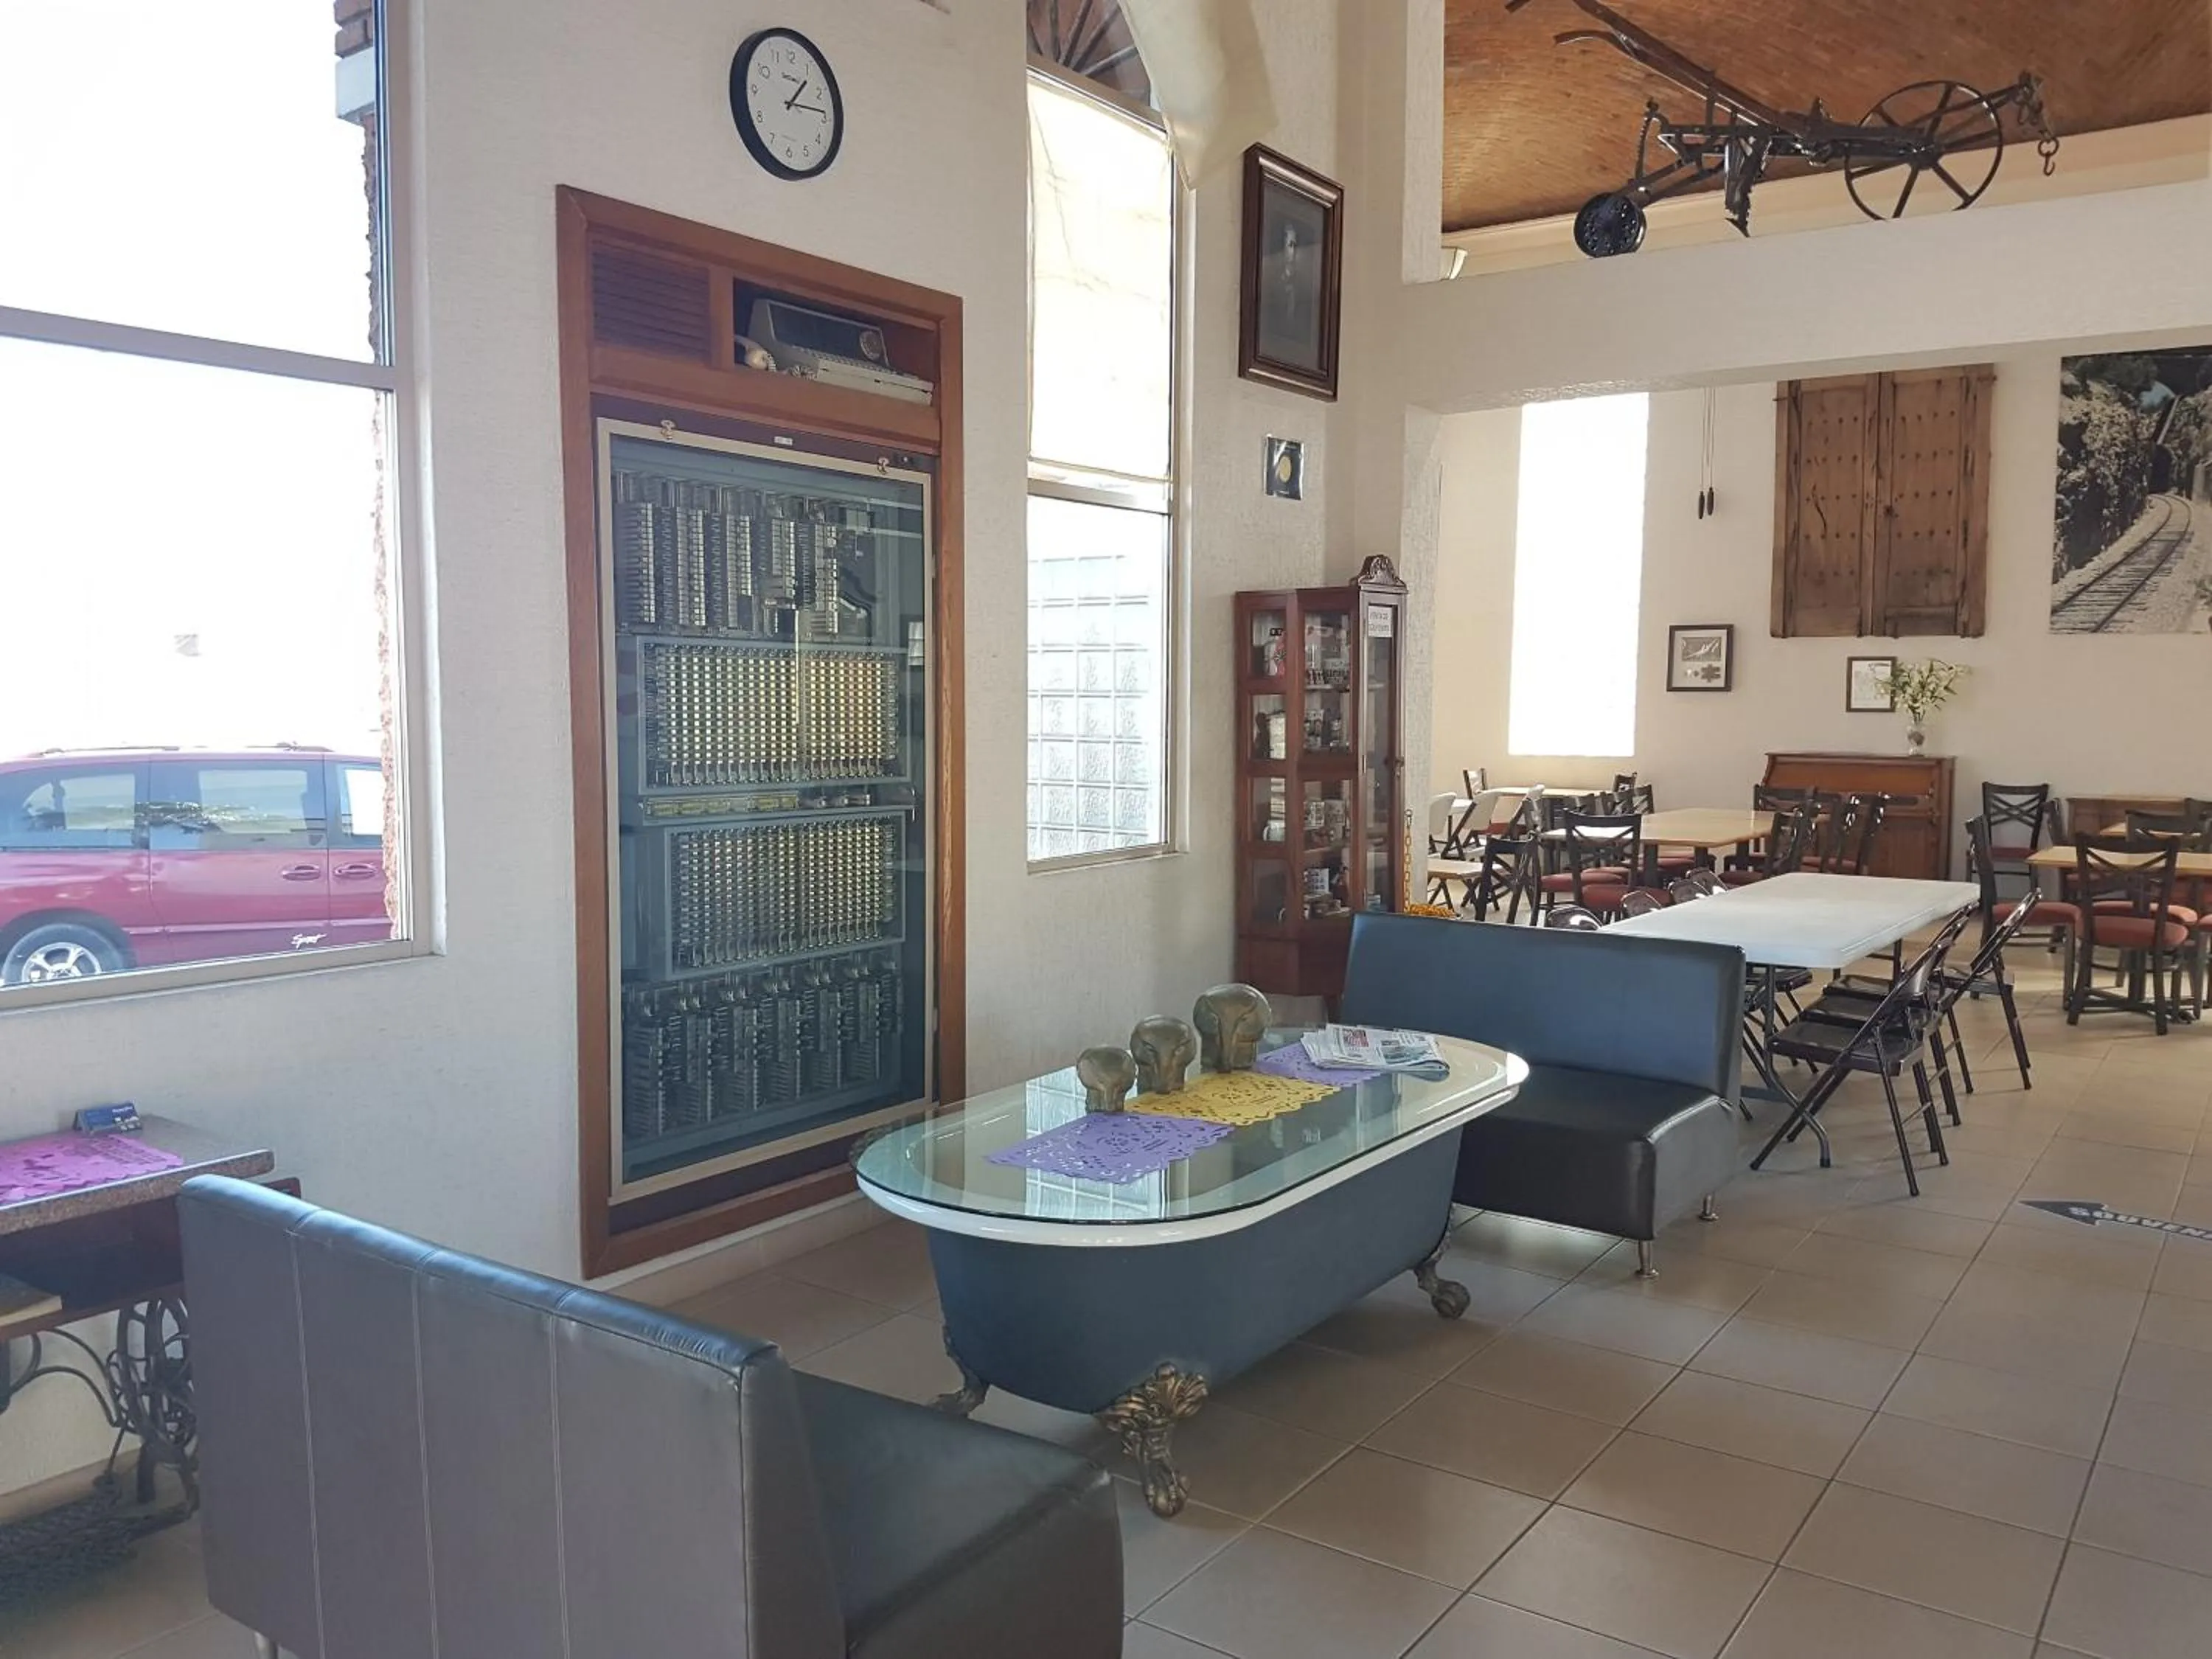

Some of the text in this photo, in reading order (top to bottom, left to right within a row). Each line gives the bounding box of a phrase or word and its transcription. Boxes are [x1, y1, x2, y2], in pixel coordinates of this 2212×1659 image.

[815, 86, 824, 100] 2
[756, 110, 764, 124] 8
[769, 132, 776, 145] 7
[785, 146, 793, 159] 6
